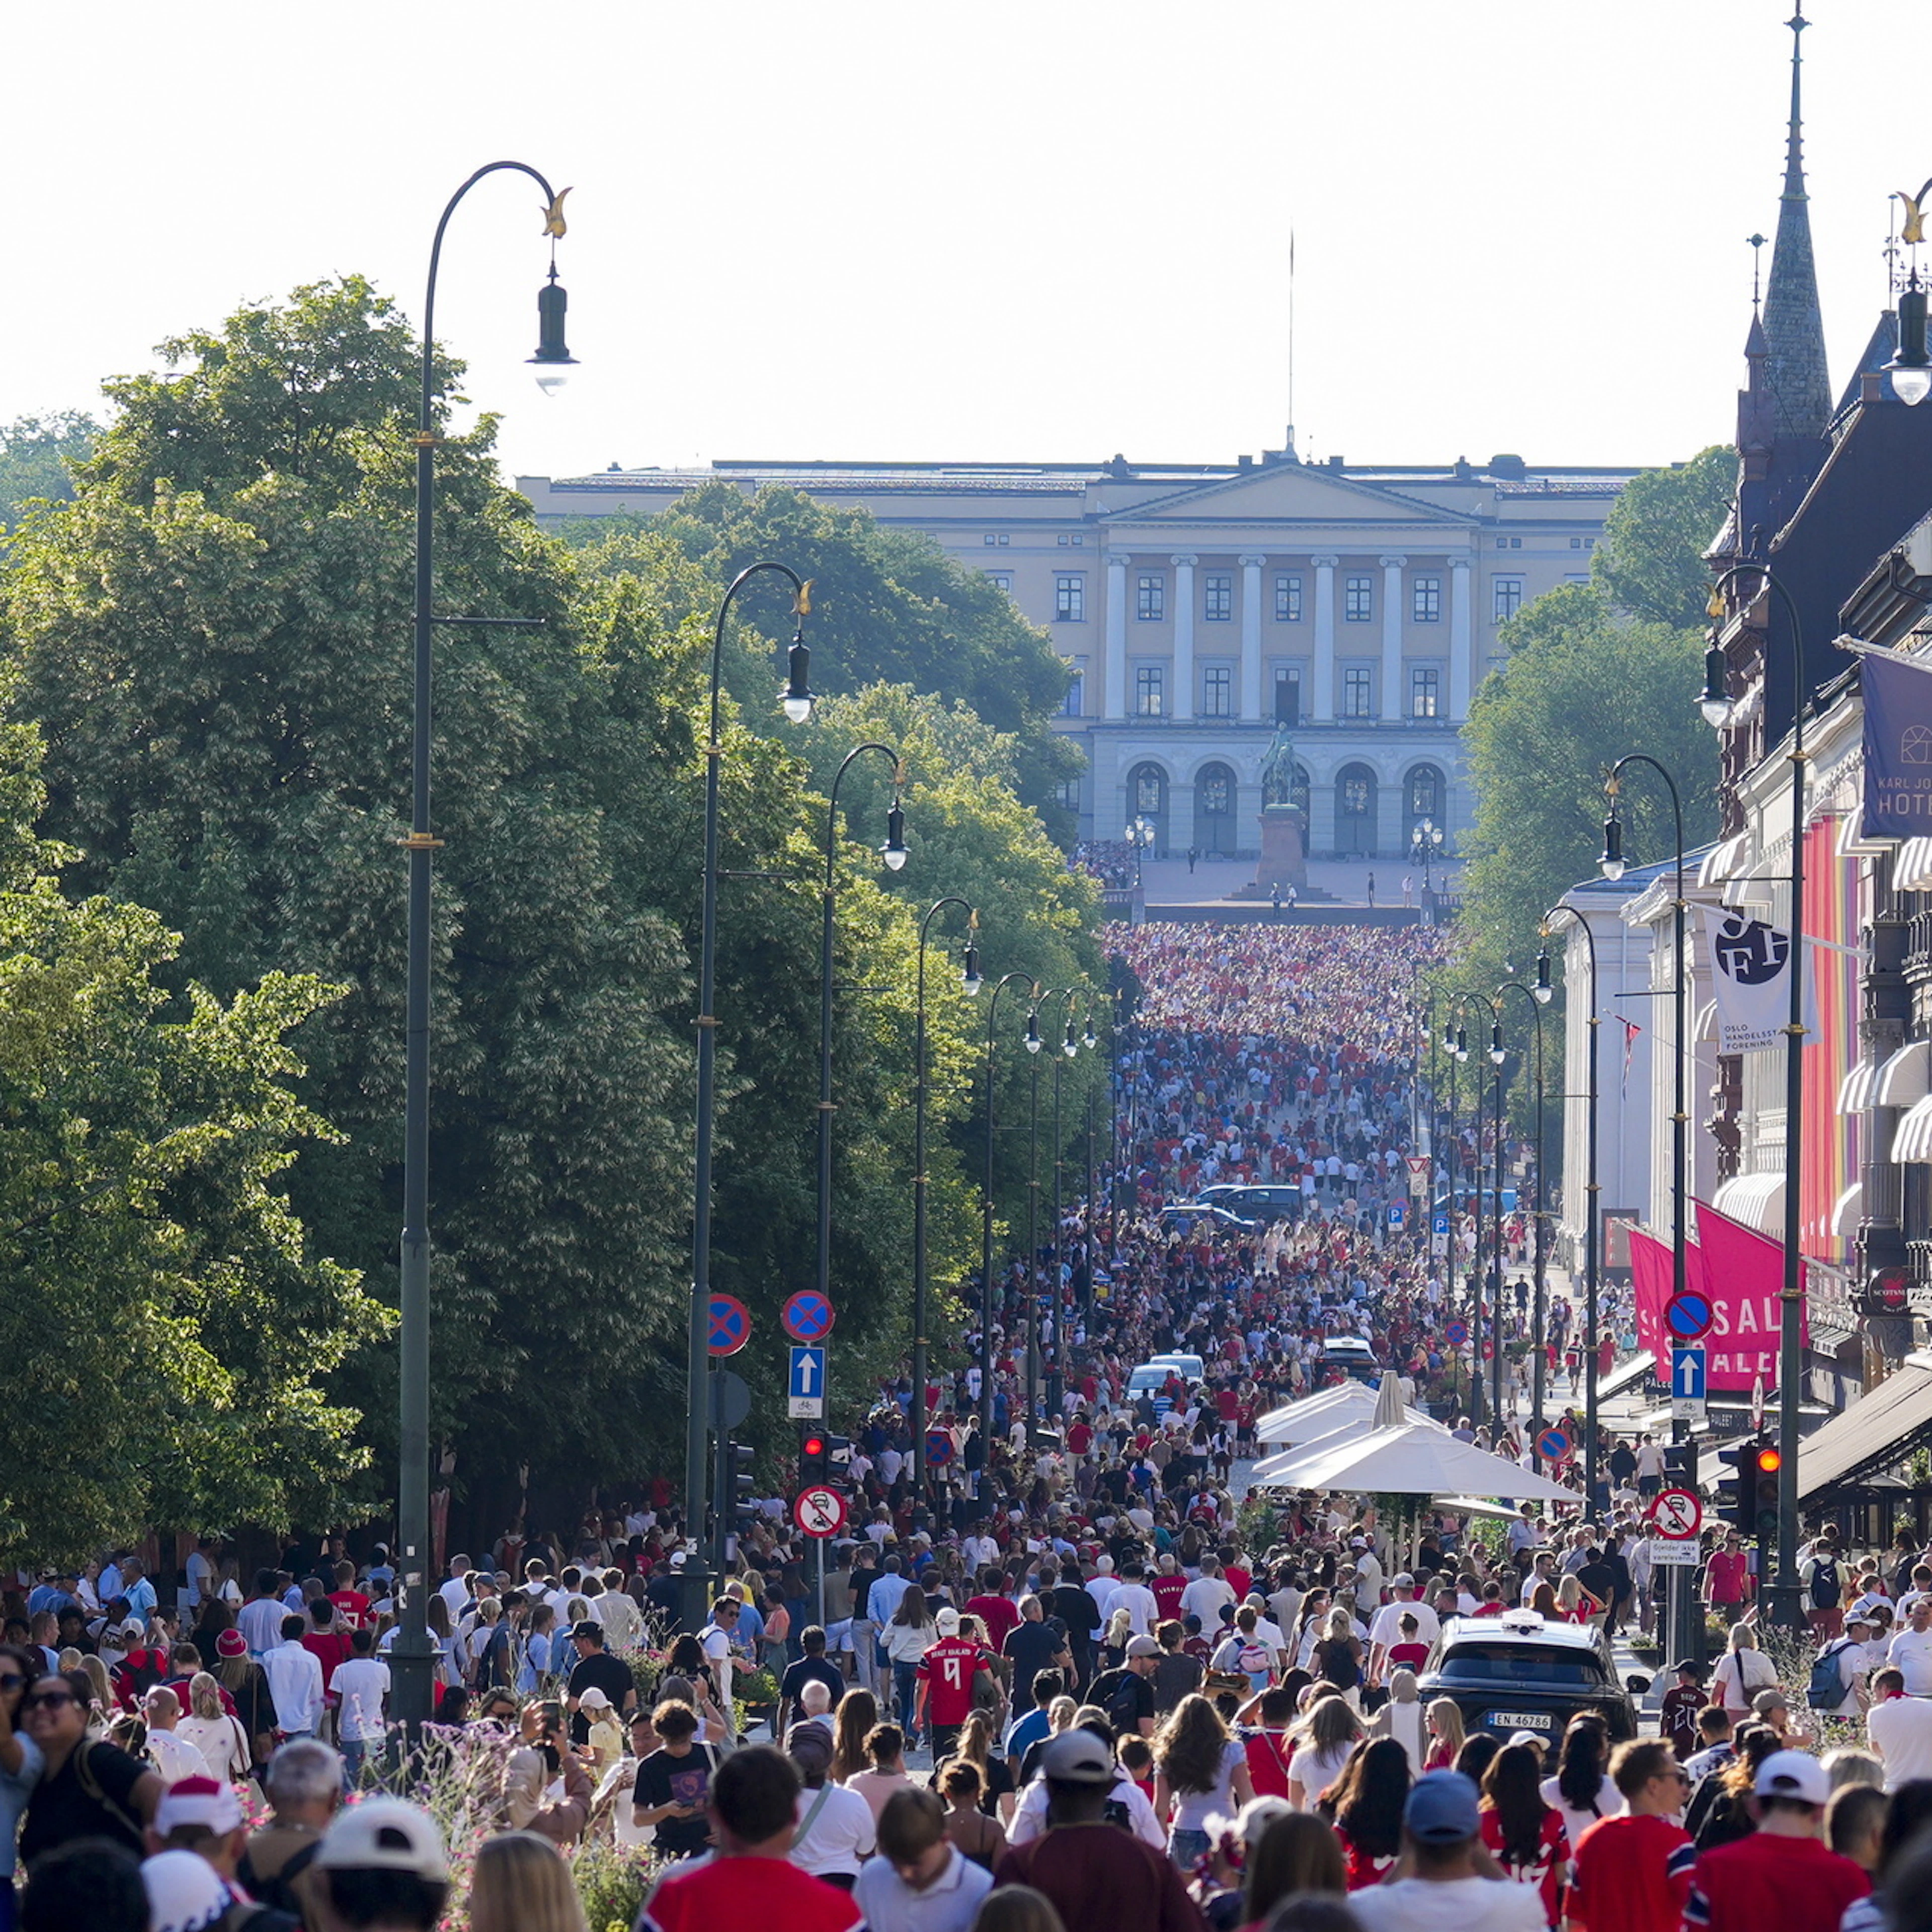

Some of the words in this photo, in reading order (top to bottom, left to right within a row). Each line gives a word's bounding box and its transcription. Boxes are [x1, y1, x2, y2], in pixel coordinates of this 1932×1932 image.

[1878, 777, 1910, 788] KARL
[1914, 778, 1932, 789] JO
[1725, 1024, 1748, 1032] OSLO
[1727, 1039, 1773, 1050] FORENING
[1391, 1209, 1400, 1222] P
[1436, 1219, 1444, 1232] P
[1713, 1297, 1782, 1336] SAL
[1645, 1377, 1672, 1388] PALEE
[943, 1658, 960, 1690] 9
[1497, 1715, 1510, 1725] EN
[1515, 1716, 1549, 1727] 46786
